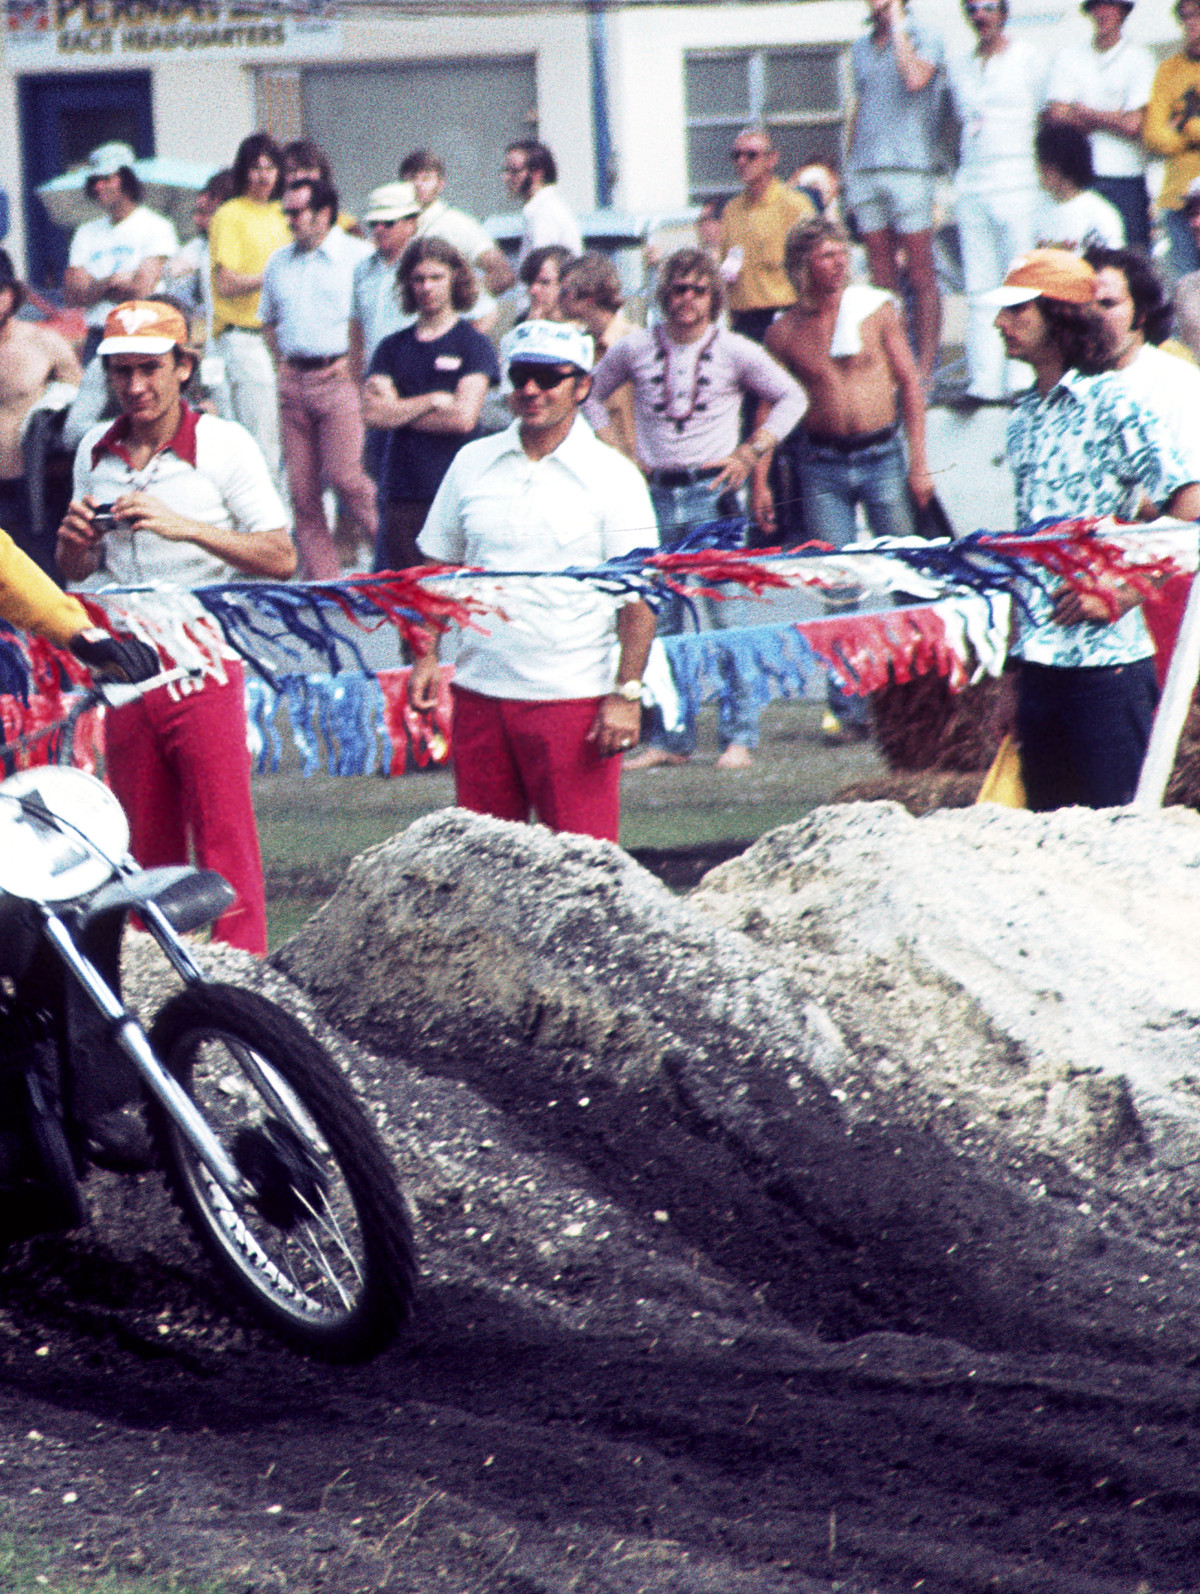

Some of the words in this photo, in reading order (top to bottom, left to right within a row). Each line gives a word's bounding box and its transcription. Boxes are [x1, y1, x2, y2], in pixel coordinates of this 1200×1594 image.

[57, 28, 113, 54] RACE
[121, 24, 286, 51] HEADQUARTERS
[14, 789, 91, 878] 1
